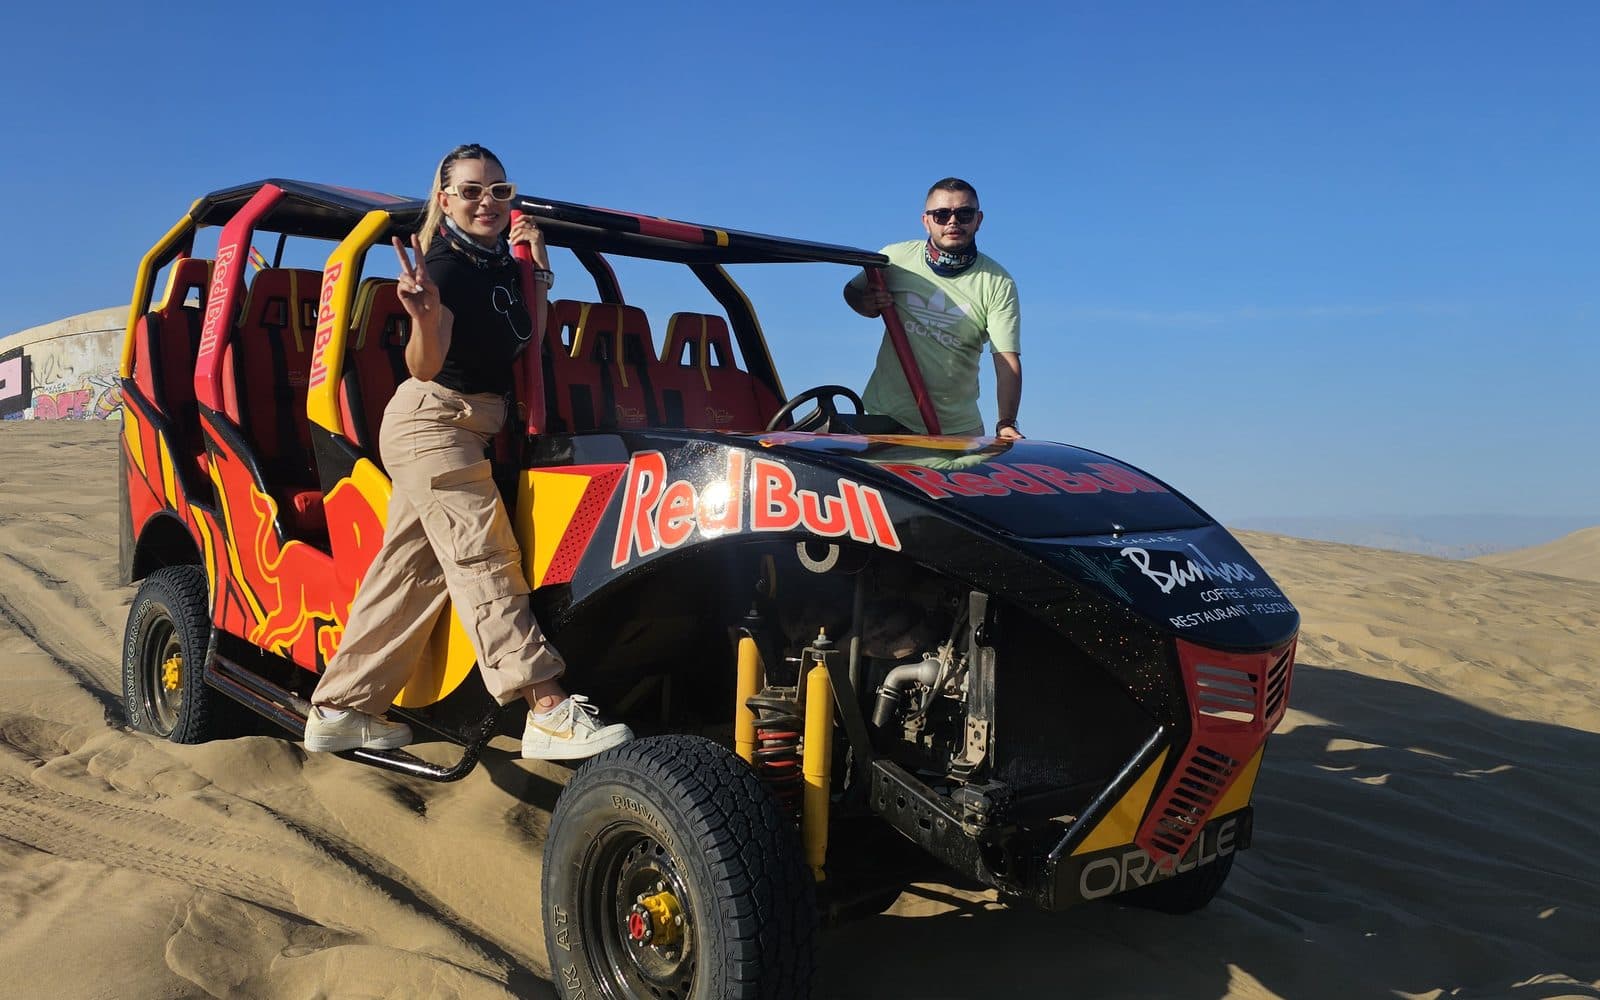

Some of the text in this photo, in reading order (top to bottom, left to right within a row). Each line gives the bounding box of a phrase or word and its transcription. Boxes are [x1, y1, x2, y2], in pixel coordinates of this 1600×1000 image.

[1200, 587, 1244, 602] COFFEE
[1246, 587, 1282, 598] HOTEL
[1169, 604, 1250, 629] RESTAURANT
[553, 904, 571, 952] AT
